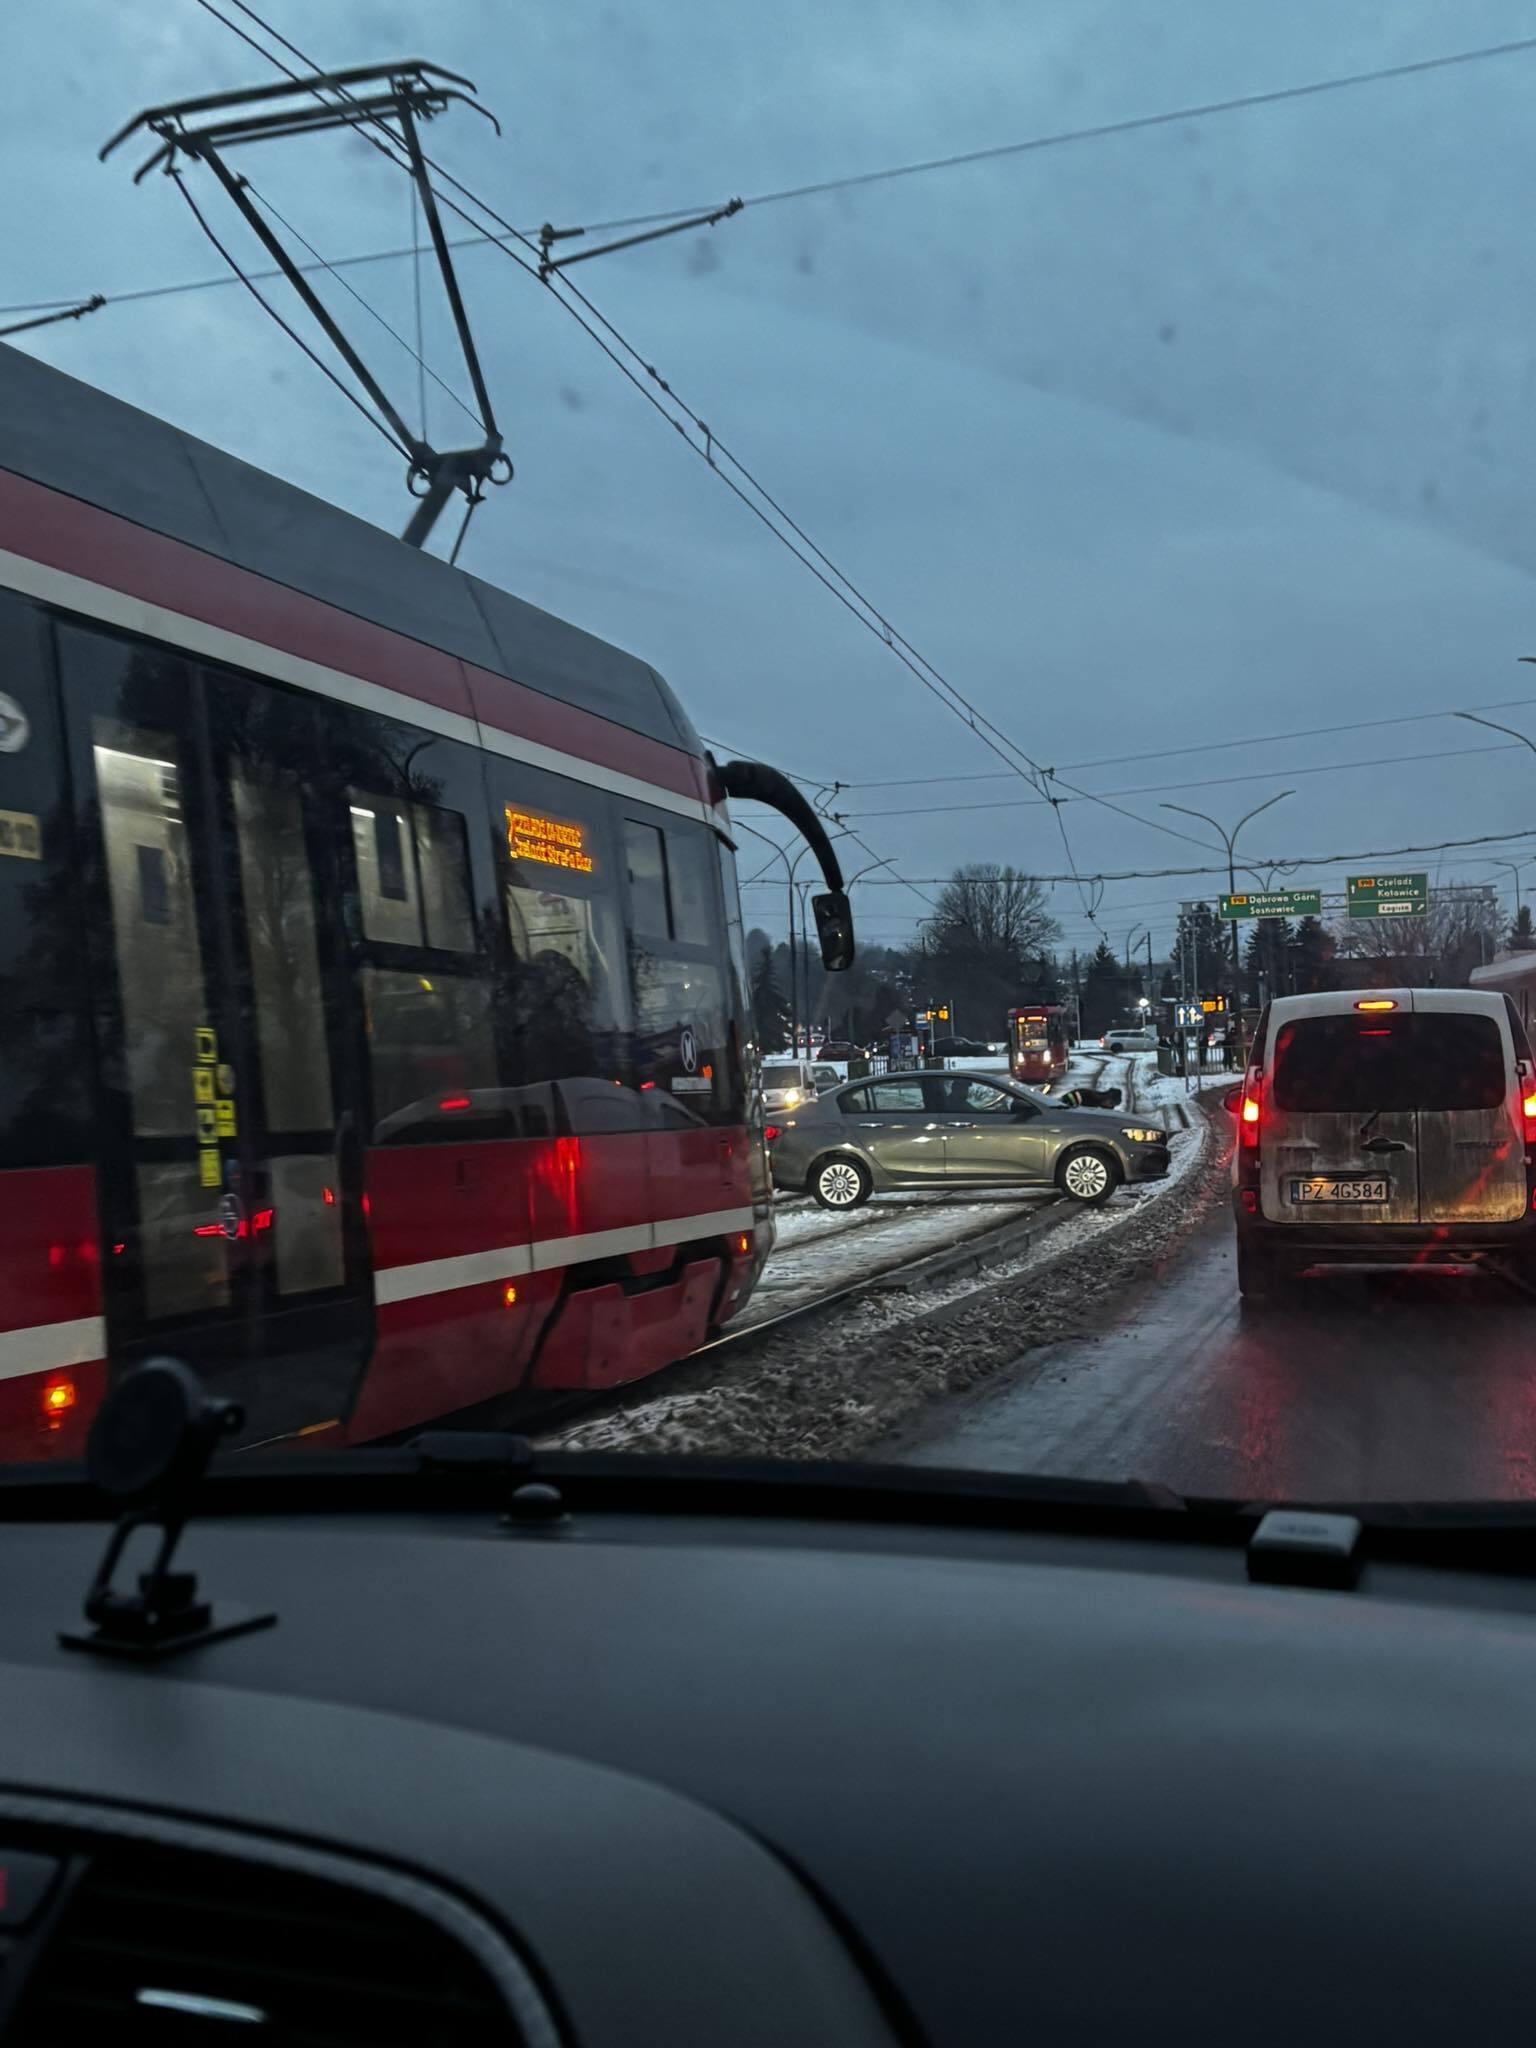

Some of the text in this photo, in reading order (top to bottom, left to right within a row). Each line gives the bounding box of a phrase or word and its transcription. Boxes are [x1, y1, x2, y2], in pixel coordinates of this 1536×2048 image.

[1377, 889, 1419, 897] Katowice
[1250, 905, 1295, 915] Sosnowiec
[1302, 1183, 1323, 1199] PZ
[1330, 1183, 1383, 1199] 4G584
